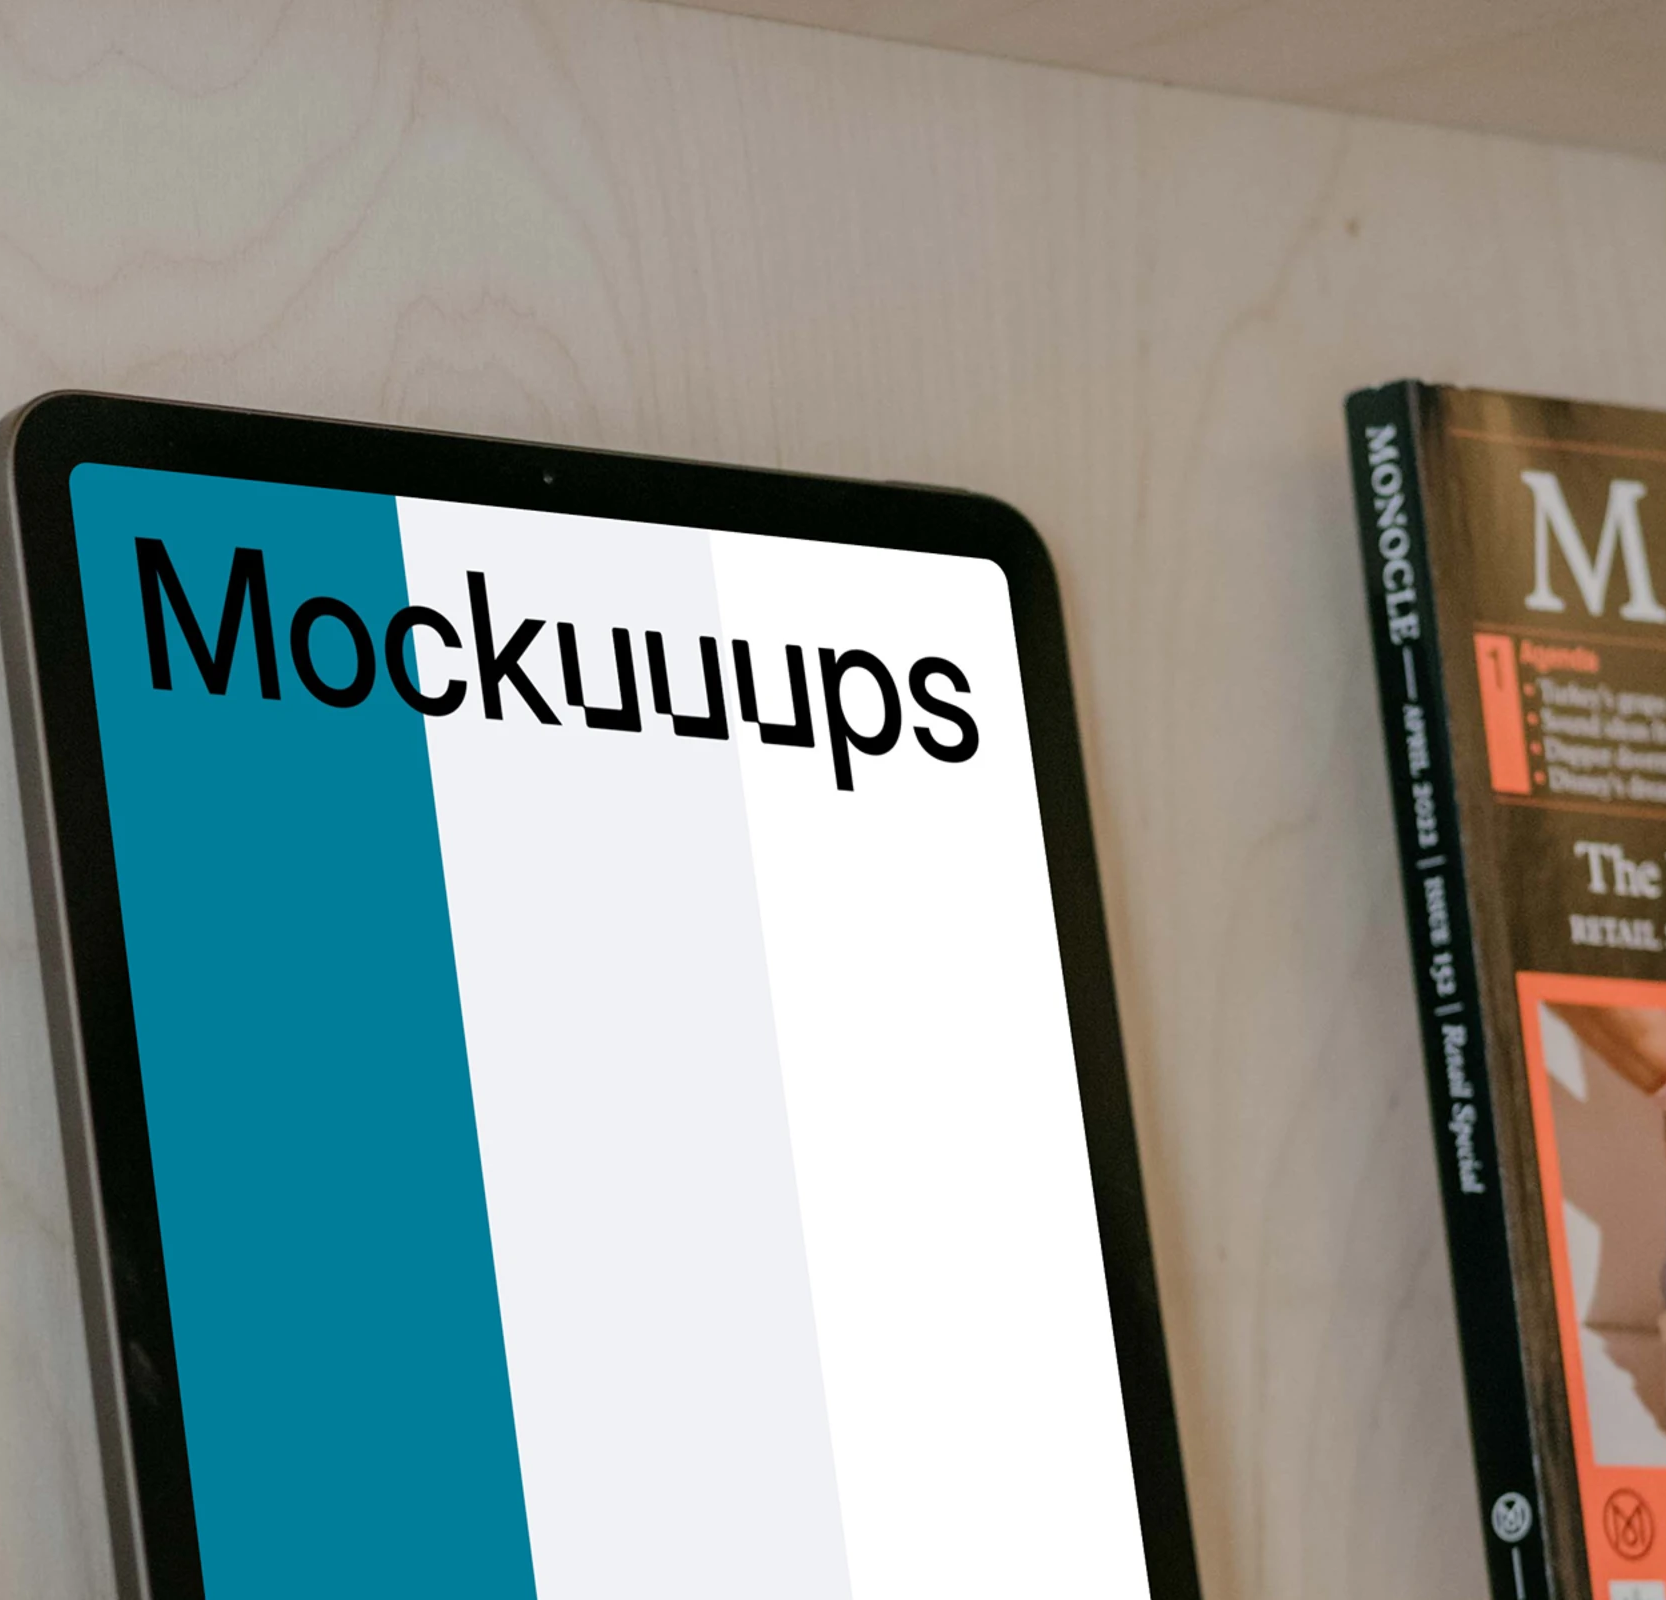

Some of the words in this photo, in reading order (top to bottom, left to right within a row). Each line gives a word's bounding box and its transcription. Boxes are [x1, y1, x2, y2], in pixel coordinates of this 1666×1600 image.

[1365, 423, 1421, 645] MONOCLE
[134, 536, 980, 791] Mockuuups
[1486, 646, 1506, 692] 1
[1412, 780, 1440, 849] 2022
[1572, 839, 1661, 899] The
[1569, 914, 1660, 954] RETAIL
[1429, 951, 1459, 998] 152
[1440, 1023, 1475, 1099] Retail
[1448, 1101, 1487, 1195] Special
